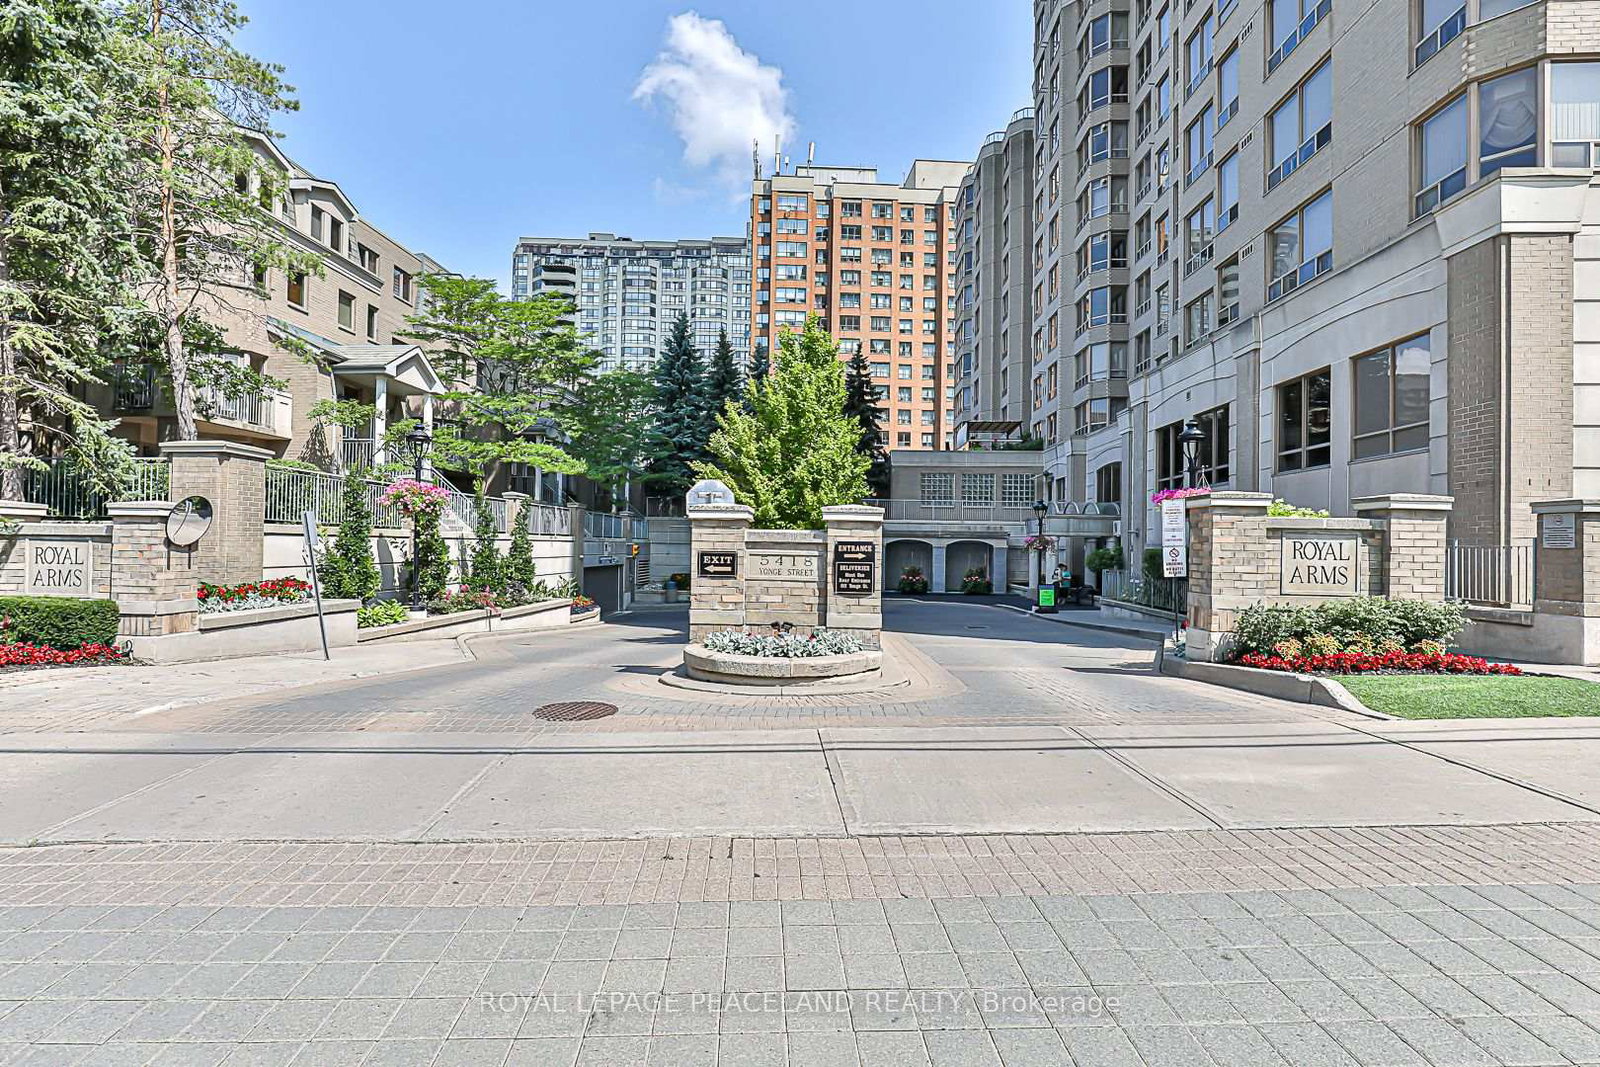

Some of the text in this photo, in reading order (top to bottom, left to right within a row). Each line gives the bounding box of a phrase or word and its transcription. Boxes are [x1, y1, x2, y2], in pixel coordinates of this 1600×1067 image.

[35, 546, 84, 565] ROYAL
[703, 555, 733, 564] EXIT
[1292, 540, 1351, 561] ROYAL
[33, 568, 82, 588] ARMS
[759, 567, 814, 577] YONGE STREET
[1289, 565, 1348, 586] ARMS
